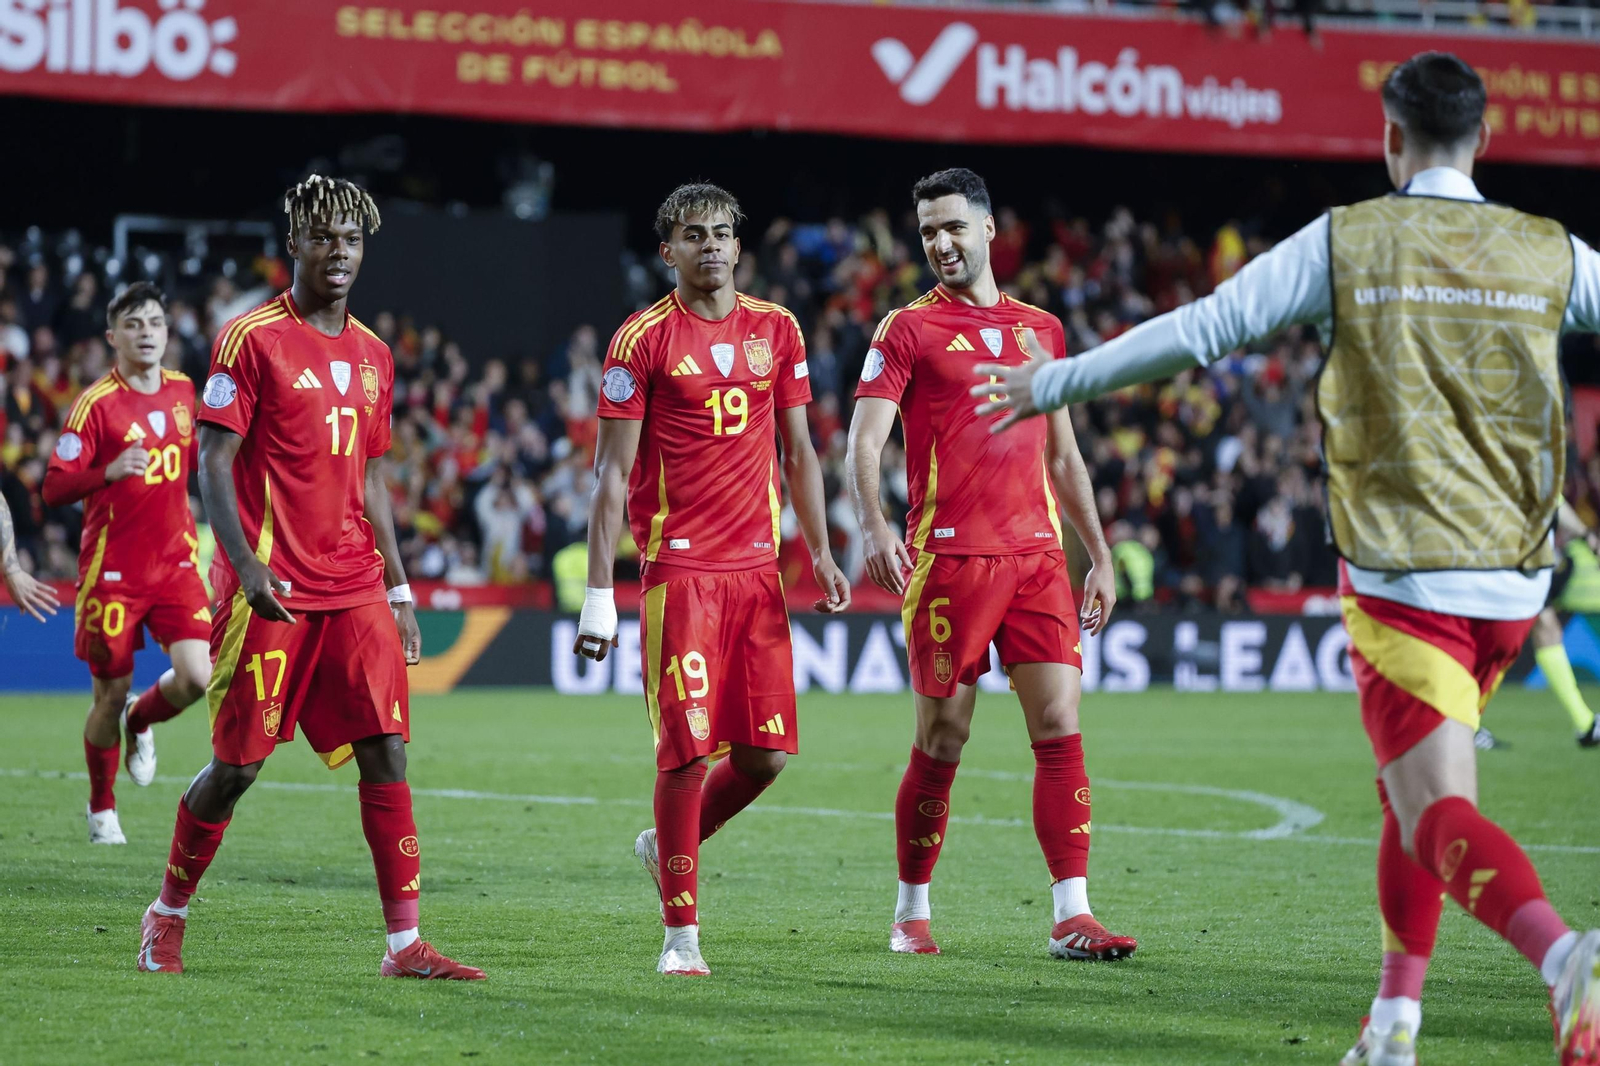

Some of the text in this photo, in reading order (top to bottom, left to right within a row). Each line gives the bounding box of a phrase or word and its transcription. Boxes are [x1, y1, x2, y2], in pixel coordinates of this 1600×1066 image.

[335, 5, 784, 59] SELECCIÓN ESPAÑOLA
[457, 49, 678, 92] DE FÚTBOL
[976, 41, 1283, 129] Halcón viajes
[1401, 285, 1482, 305] NATIONS
[325, 405, 359, 457] 17
[704, 387, 749, 436] 19
[144, 443, 181, 485] 20
[84, 597, 125, 637] 20
[928, 597, 952, 645] 6
[245, 648, 288, 702] 17
[665, 650, 710, 702] 19
